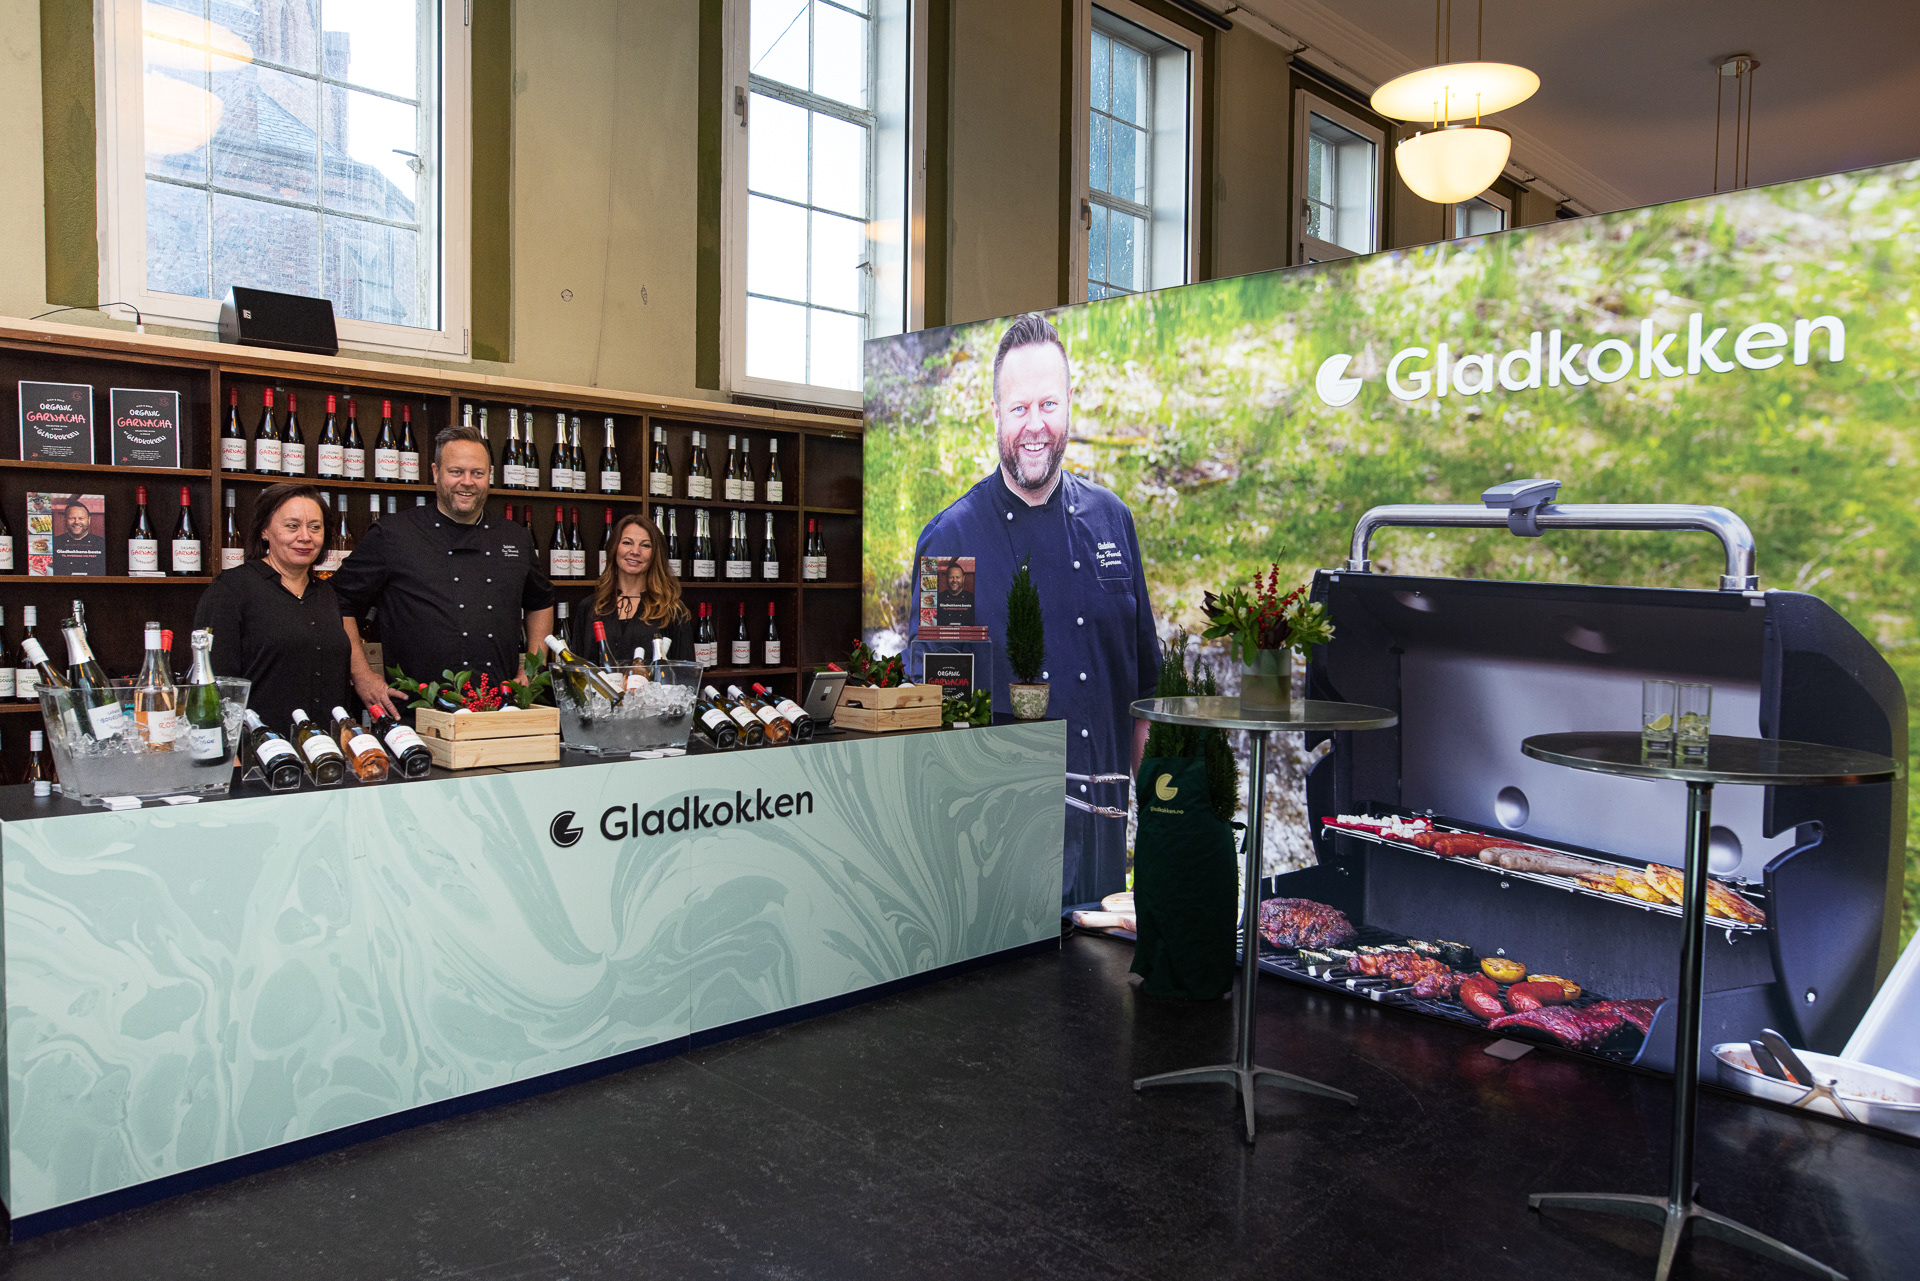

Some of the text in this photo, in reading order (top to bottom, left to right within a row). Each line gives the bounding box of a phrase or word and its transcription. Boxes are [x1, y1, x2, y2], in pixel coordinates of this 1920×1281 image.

[1386, 312, 1846, 401] Gladkokken
[40, 403, 72, 411] ORGANIC
[129, 409, 160, 417] ORGANIC
[26, 411, 86, 424] GARNACHA
[117, 417, 173, 429] GARNACHA
[928, 677, 969, 687] GARNACHA
[600, 788, 813, 841] Gladkokken
